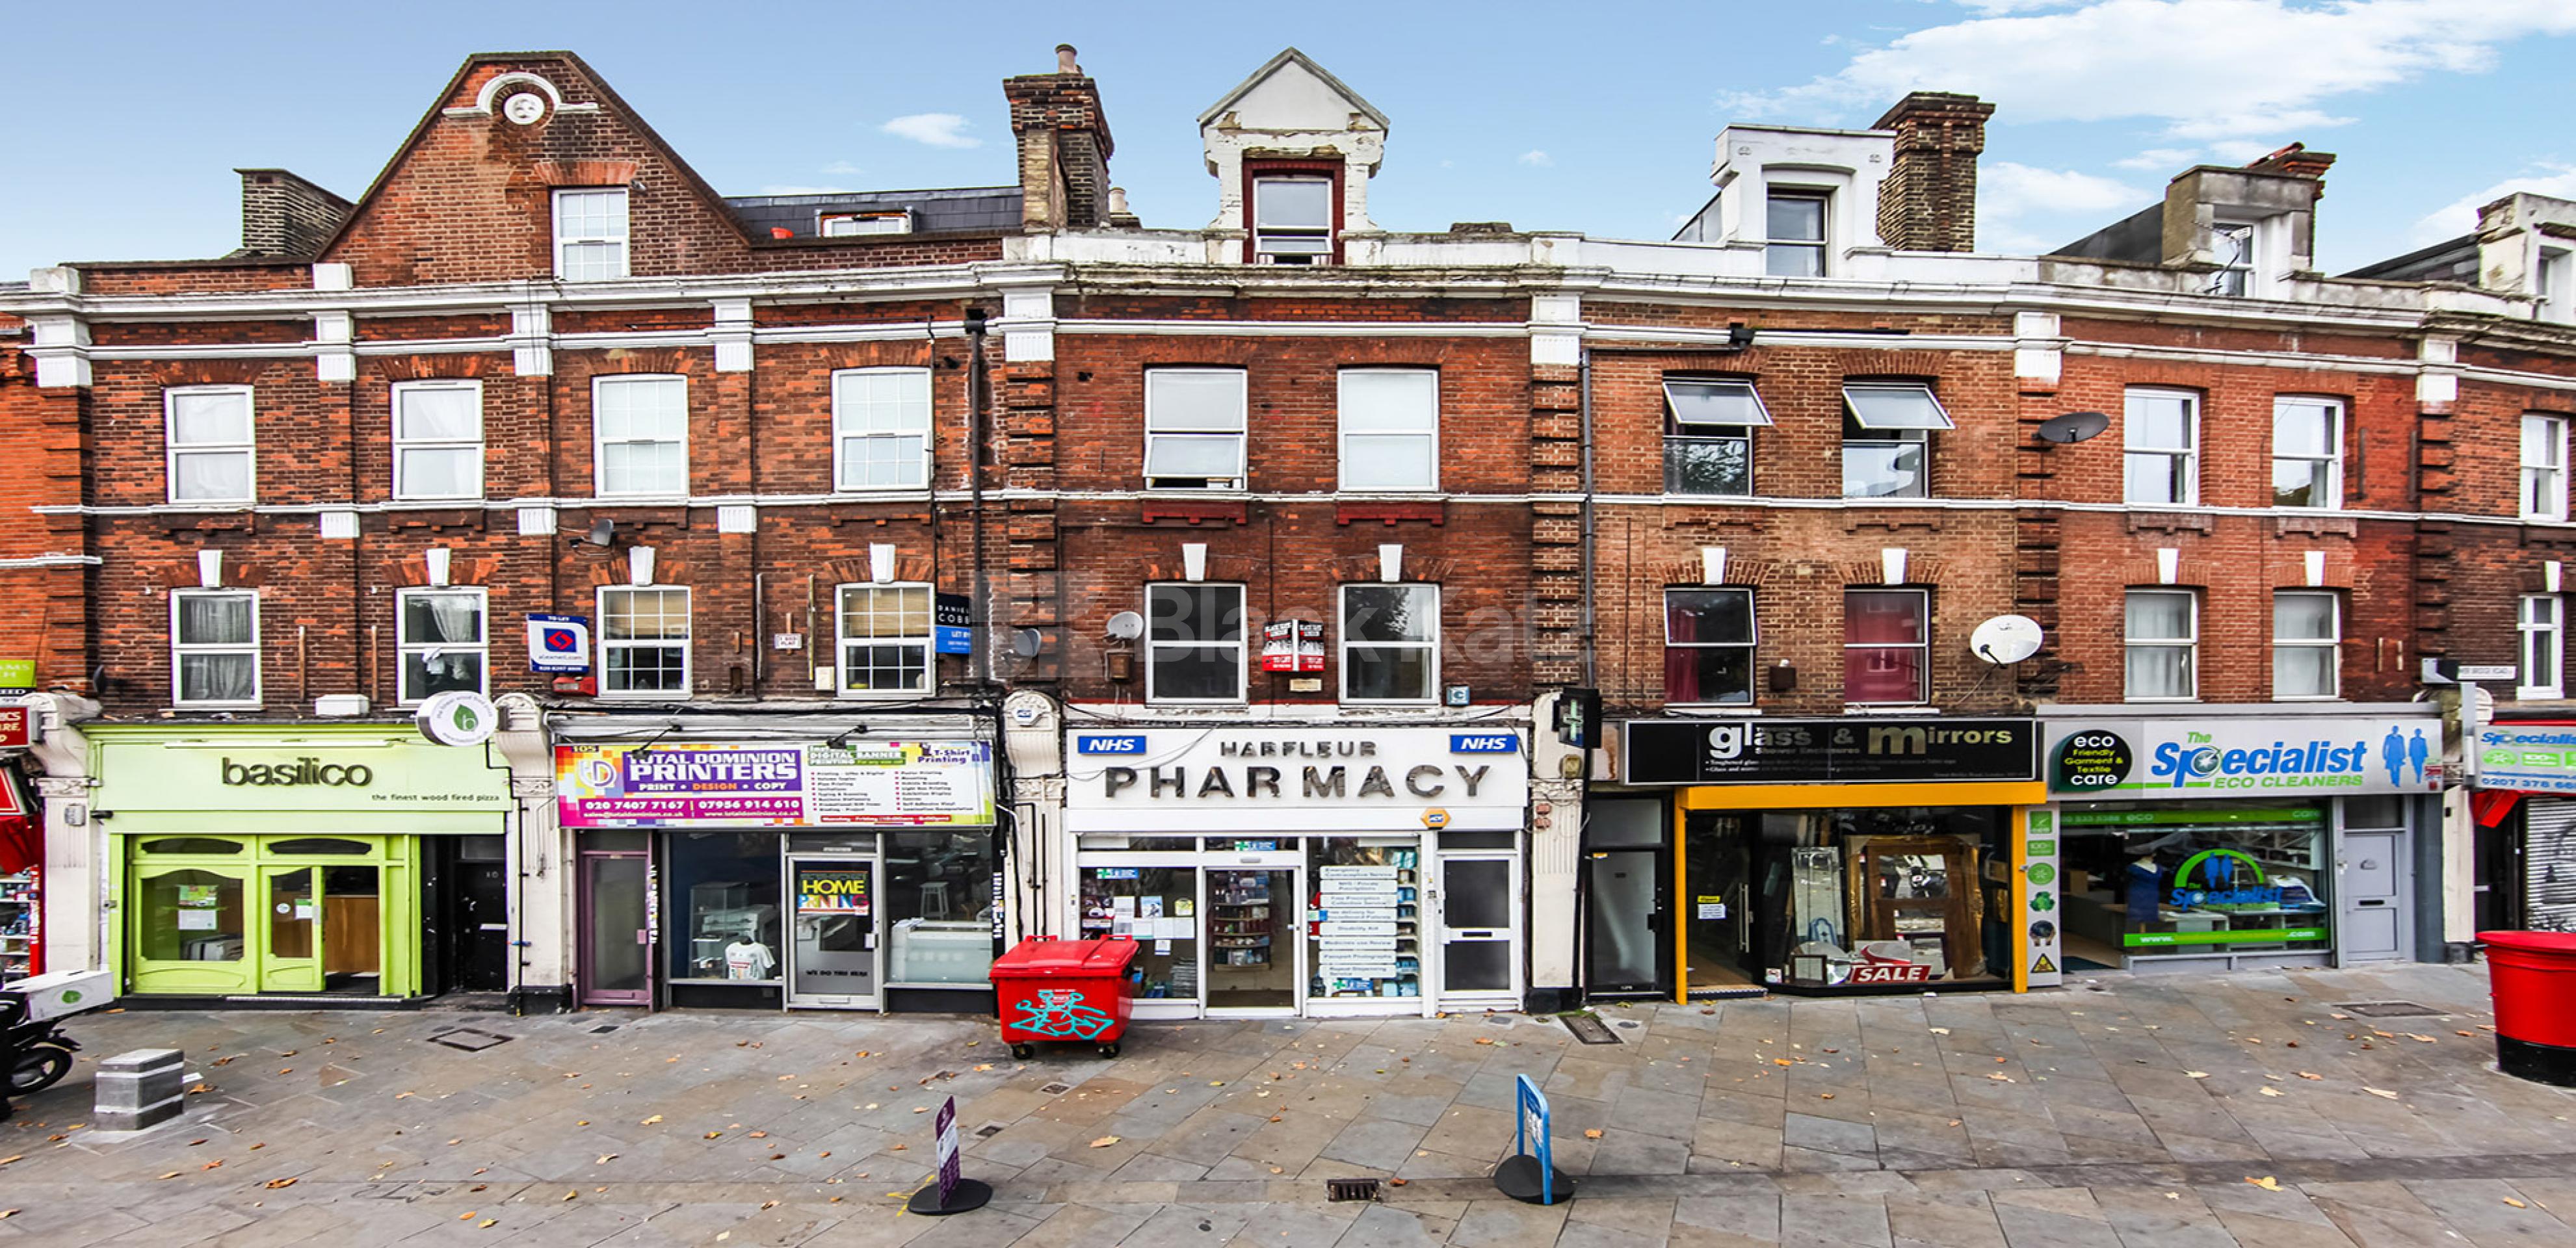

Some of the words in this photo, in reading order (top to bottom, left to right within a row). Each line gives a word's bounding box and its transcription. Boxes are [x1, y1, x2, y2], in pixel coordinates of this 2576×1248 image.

[1461, 737, 1508, 750] NHS
[1709, 722, 1811, 759] glass
[1833, 727, 1854, 744] &
[1868, 726, 2012, 754] mirrors
[2073, 736, 2115, 747] eco
[2187, 731, 2212, 744] The
[1088, 738, 1135, 752] NHS
[1220, 741, 1376, 757] HARFLEUR
[694, 753, 796, 764] DOMINION
[917, 756, 967, 765] Printing
[2064, 757, 2113, 766] Garment
[2151, 740, 2368, 788] Specialist
[222, 757, 373, 786] basilico
[630, 764, 797, 781] PRINTERS
[638, 783, 676, 791] PRINT
[692, 782, 737, 790] DESIGN
[754, 781, 787, 790] COPY
[1105, 764, 1490, 798] PHARMACY
[2071, 774, 2118, 786] care
[2214, 776, 2255, 788] ECO
[2261, 775, 2363, 788] CLEANERS
[585, 801, 611, 810] 020
[614, 801, 648, 809] 7407
[651, 801, 685, 809] 7167
[744, 800, 770, 809] 914
[774, 800, 800, 808] 610
[802, 879, 865, 894] HOME
[1857, 967, 1923, 982] SALE
